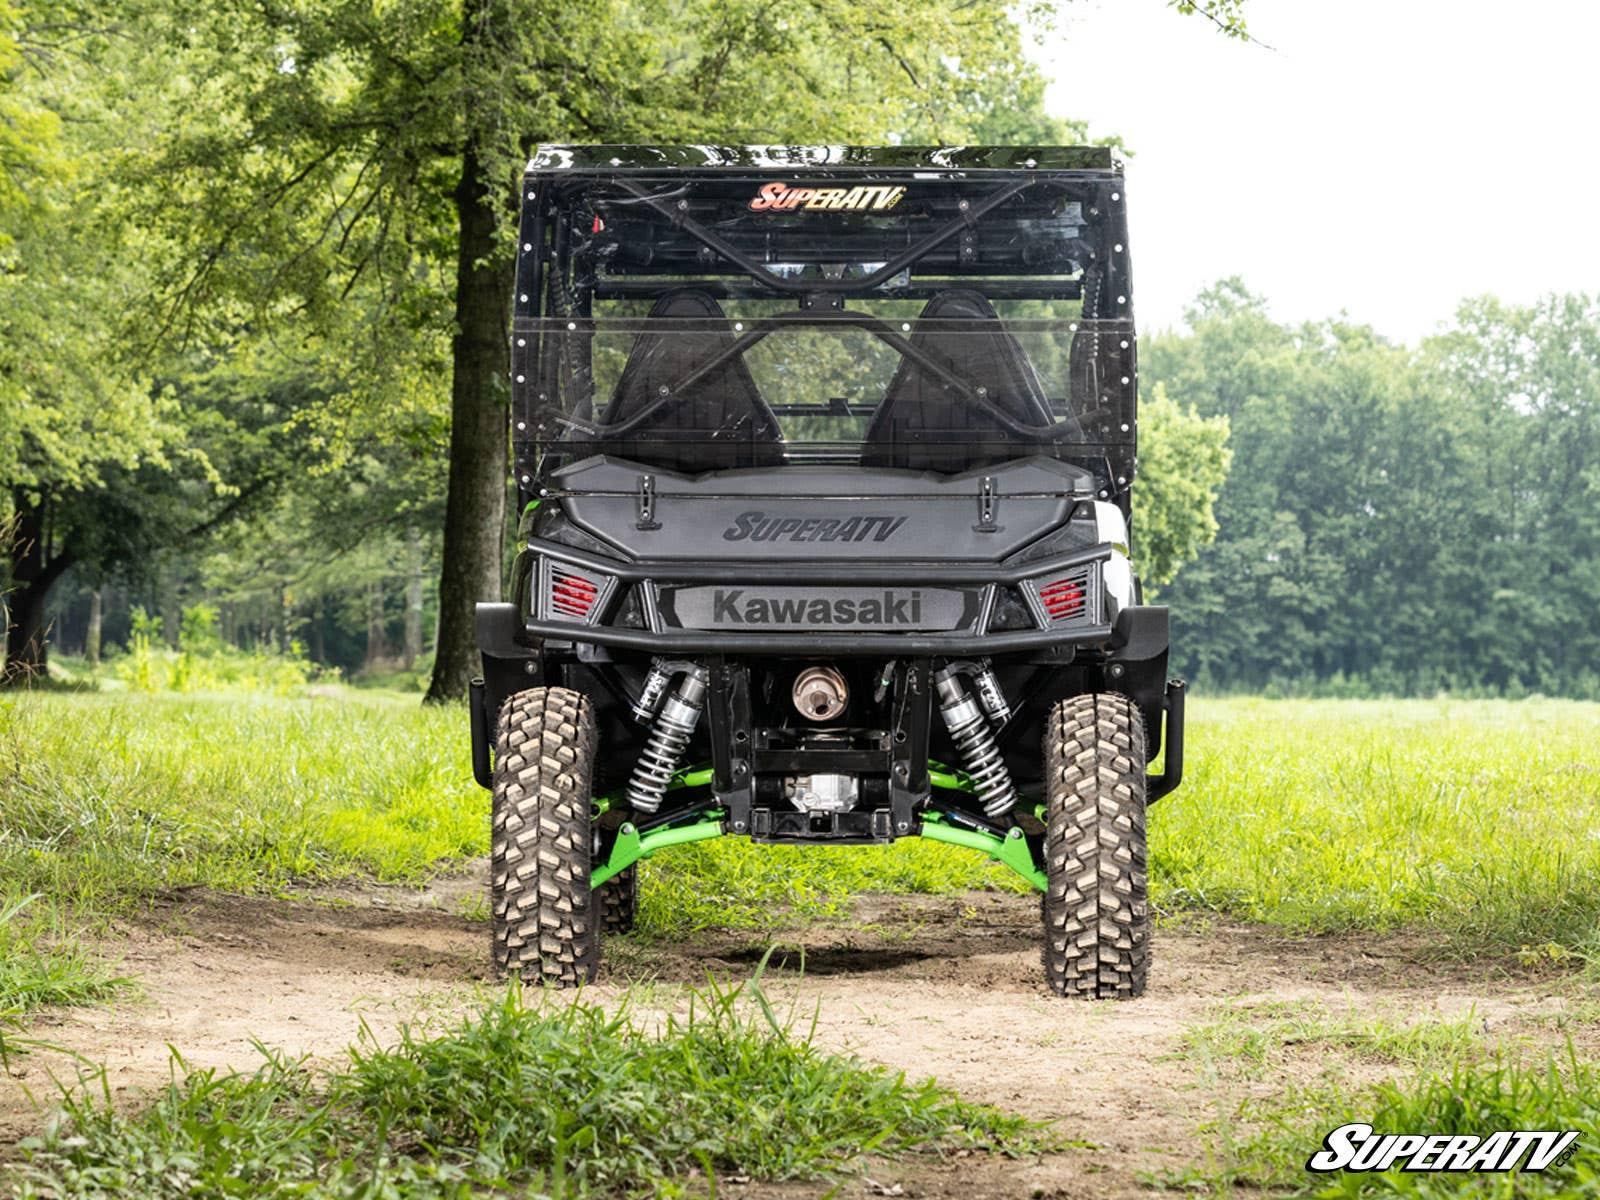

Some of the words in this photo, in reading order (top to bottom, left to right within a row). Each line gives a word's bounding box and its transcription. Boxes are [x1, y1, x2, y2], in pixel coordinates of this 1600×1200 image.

[750, 182, 902, 210] SUPERATV
[722, 511, 909, 542] SUPERATV
[713, 590, 921, 624] Kawasaki
